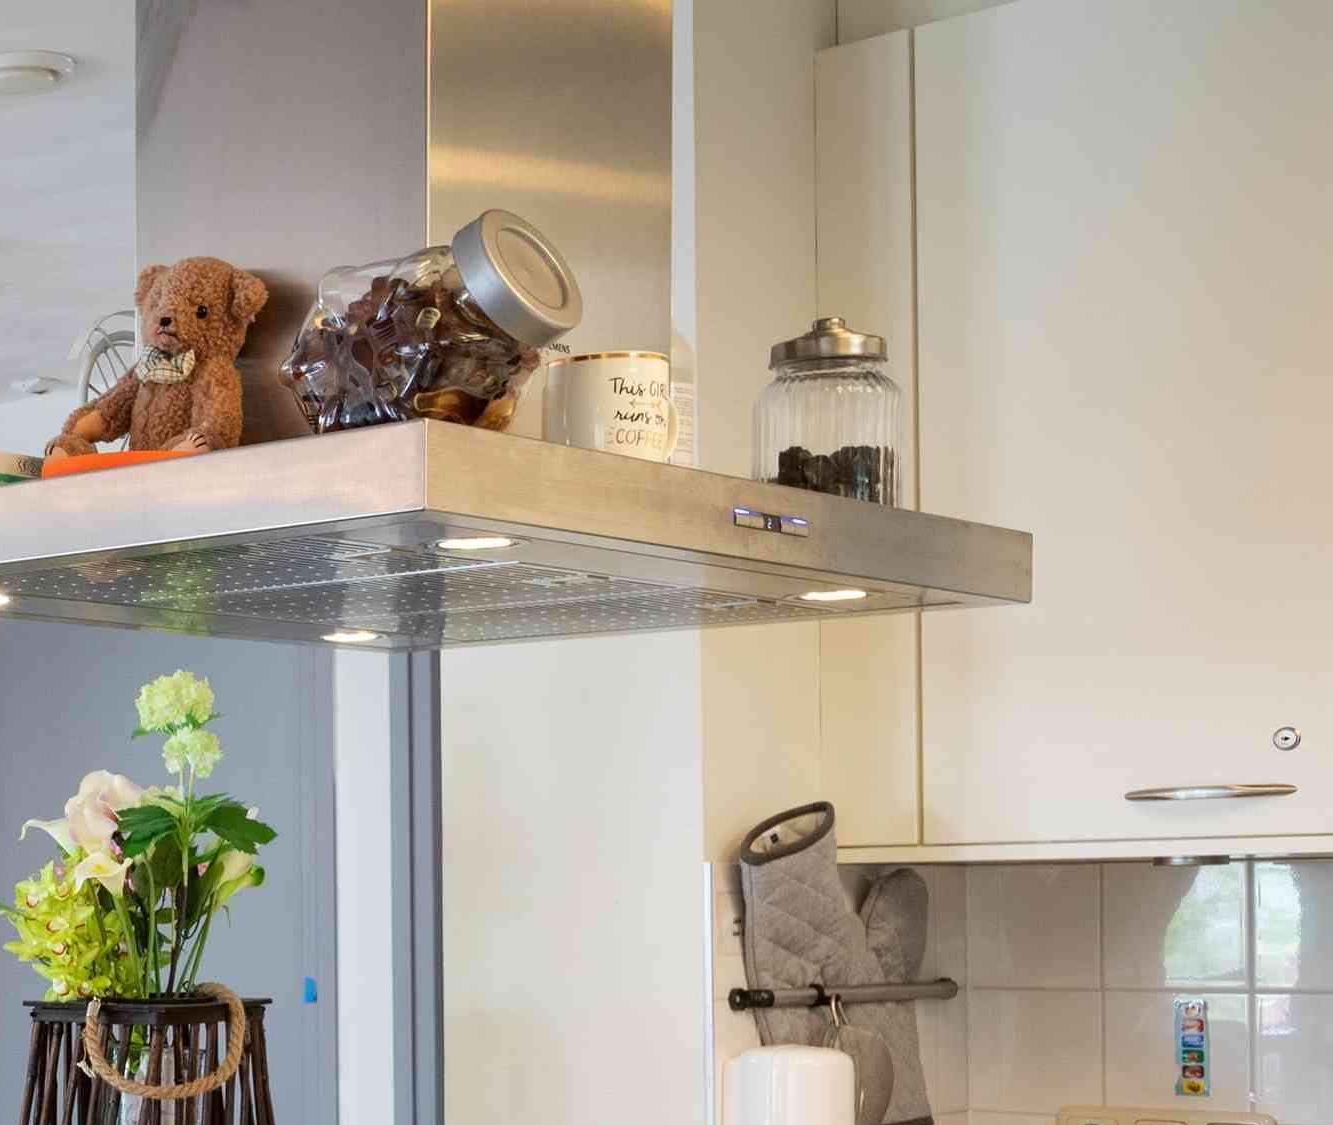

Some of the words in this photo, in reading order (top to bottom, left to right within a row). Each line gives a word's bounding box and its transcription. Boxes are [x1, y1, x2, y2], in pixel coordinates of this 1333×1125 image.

[549, 343, 571, 354] MENS
[608, 376, 647, 397] This
[613, 410, 651, 425] runs
[615, 428, 668, 450] COFFEE
